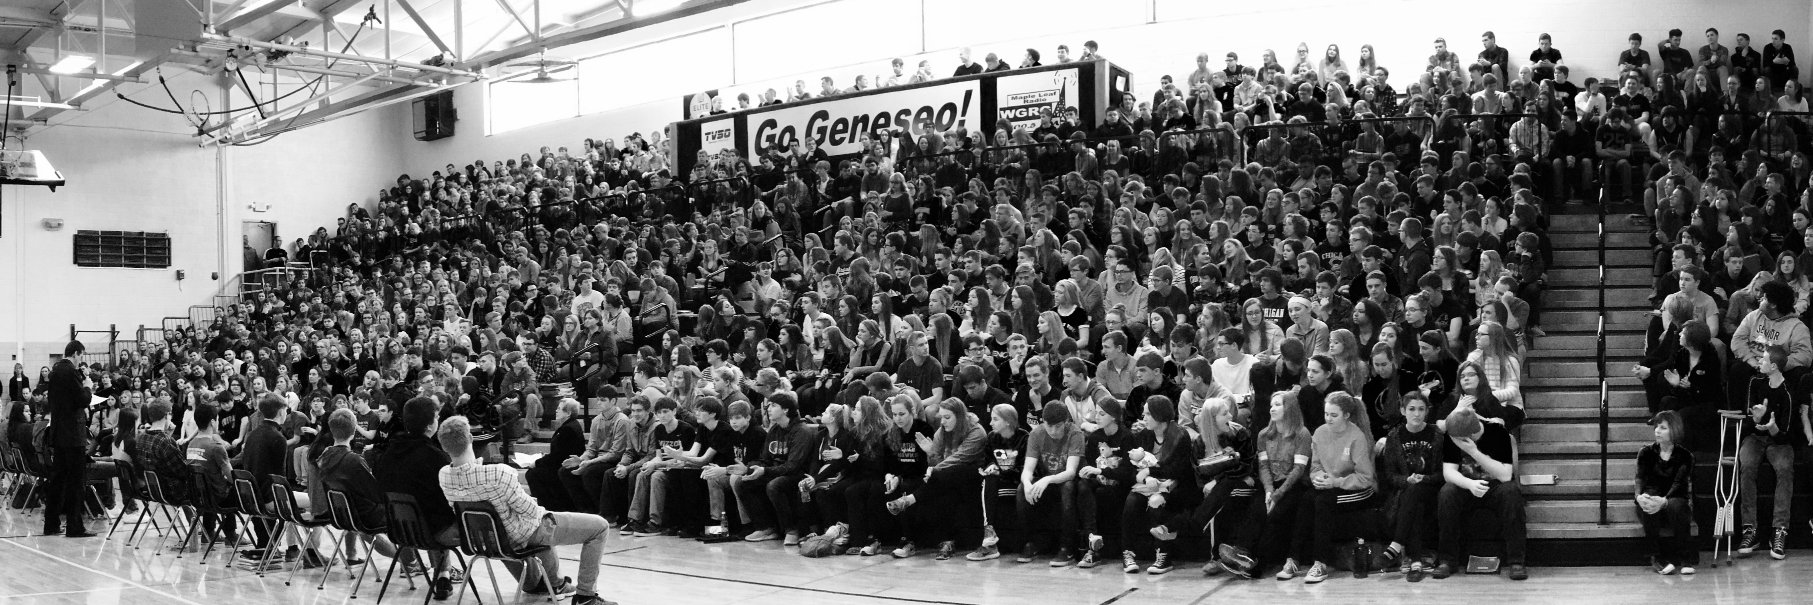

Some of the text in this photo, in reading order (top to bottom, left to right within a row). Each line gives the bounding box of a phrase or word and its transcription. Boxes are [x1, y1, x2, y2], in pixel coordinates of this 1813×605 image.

[1011, 94, 1036, 102] Maple
[755, 89, 973, 156] Go Geneseo!
[1321, 251, 1344, 260] CHICA
